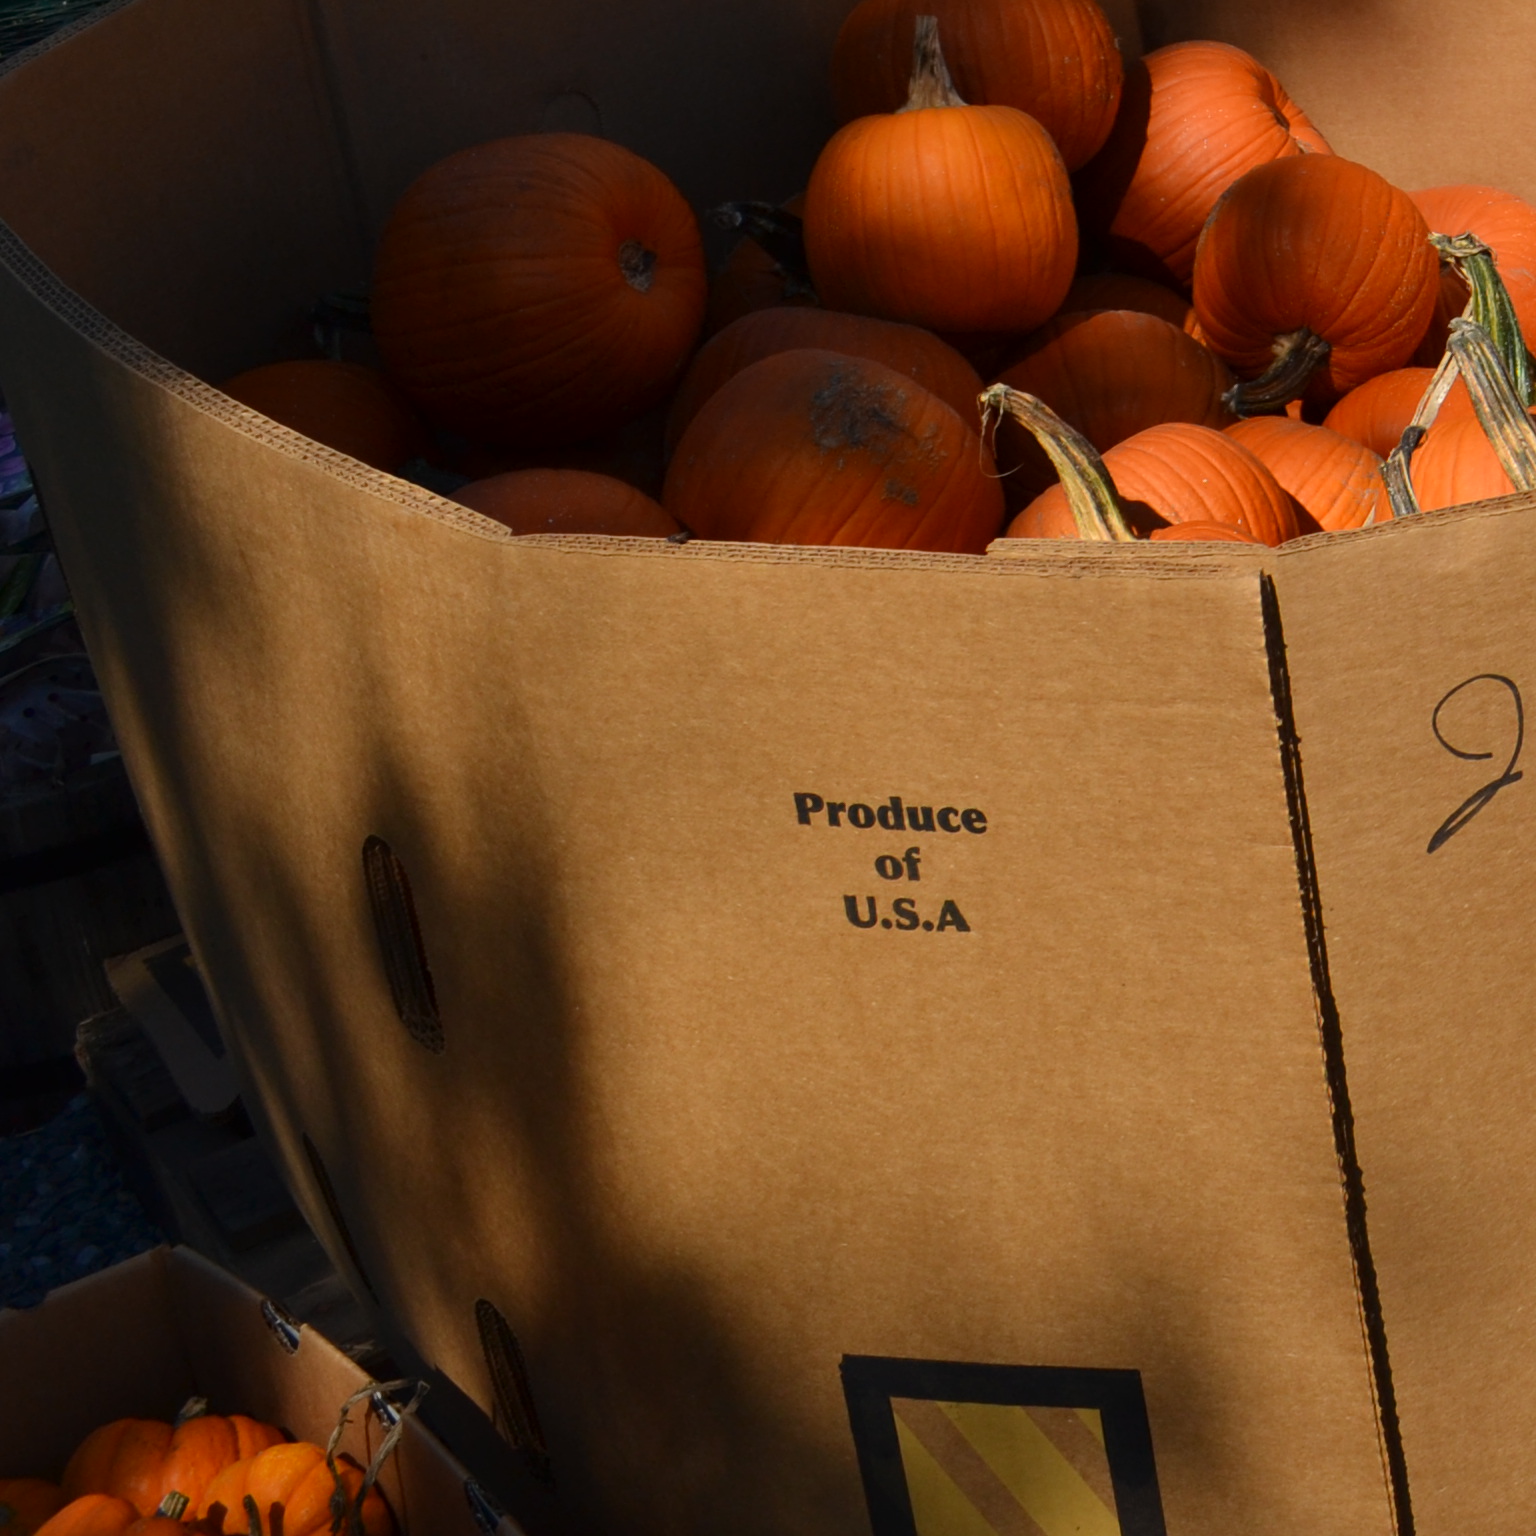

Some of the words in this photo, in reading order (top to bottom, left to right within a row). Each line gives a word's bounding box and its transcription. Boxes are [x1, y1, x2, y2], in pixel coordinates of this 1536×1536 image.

[793, 792, 988, 835] Produce
[874, 846, 921, 881] of
[843, 894, 971, 933] U.S.A
